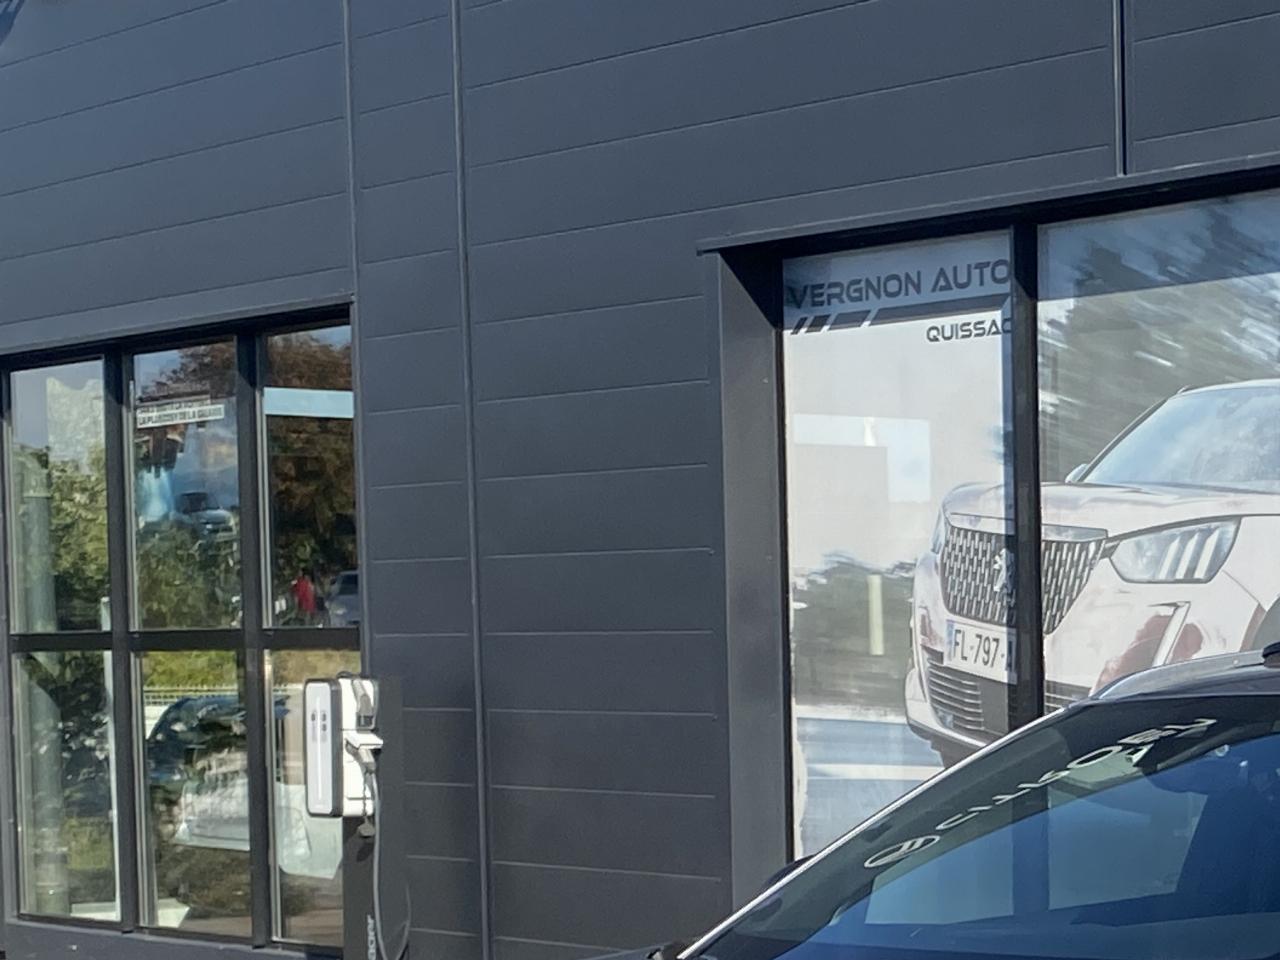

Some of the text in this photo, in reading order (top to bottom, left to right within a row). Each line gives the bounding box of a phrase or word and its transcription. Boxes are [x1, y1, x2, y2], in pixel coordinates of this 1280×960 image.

[785, 259, 1011, 309] VERGNON AUTO
[926, 317, 1012, 342] QUISSAC
